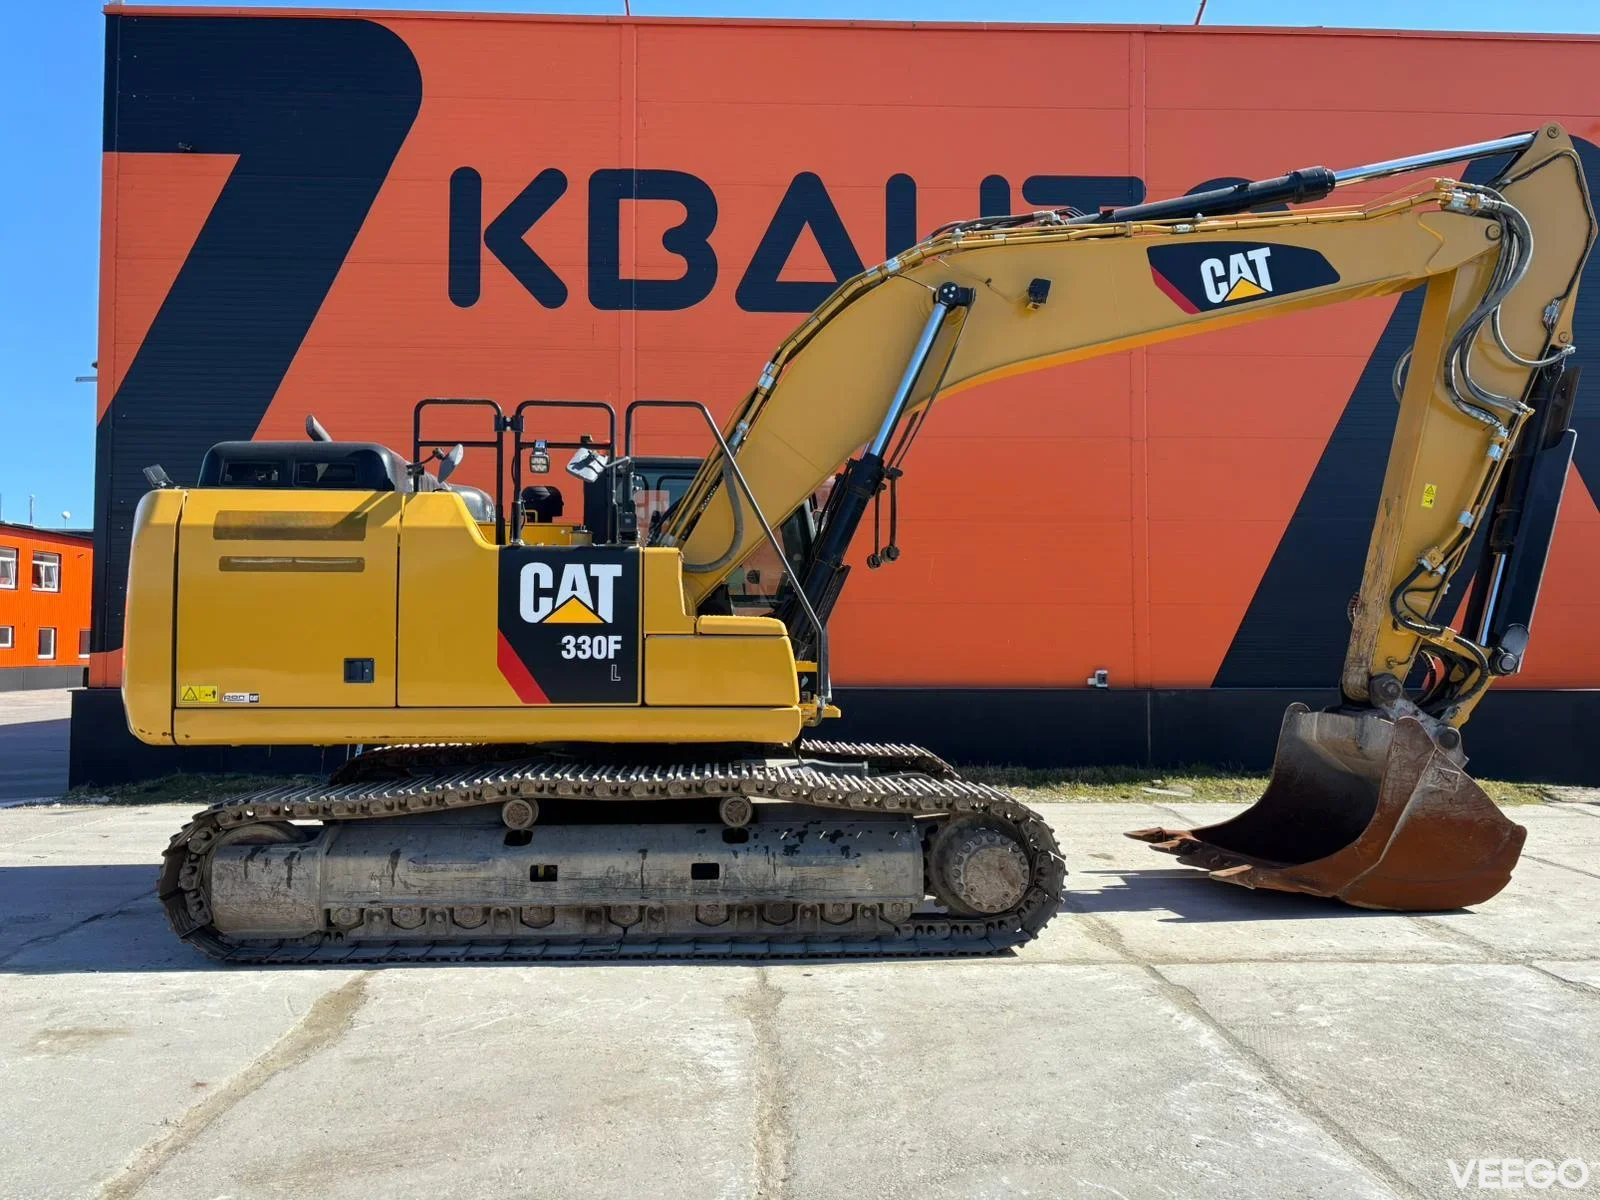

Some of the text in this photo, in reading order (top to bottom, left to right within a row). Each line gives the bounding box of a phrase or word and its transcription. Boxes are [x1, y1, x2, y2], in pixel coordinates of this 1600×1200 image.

[449, 166, 1291, 313] KBAT
[1200, 247, 1273, 304] CAT
[519, 562, 623, 624] CAT
[561, 635, 622, 660] 330F
[610, 664, 621, 682] L
